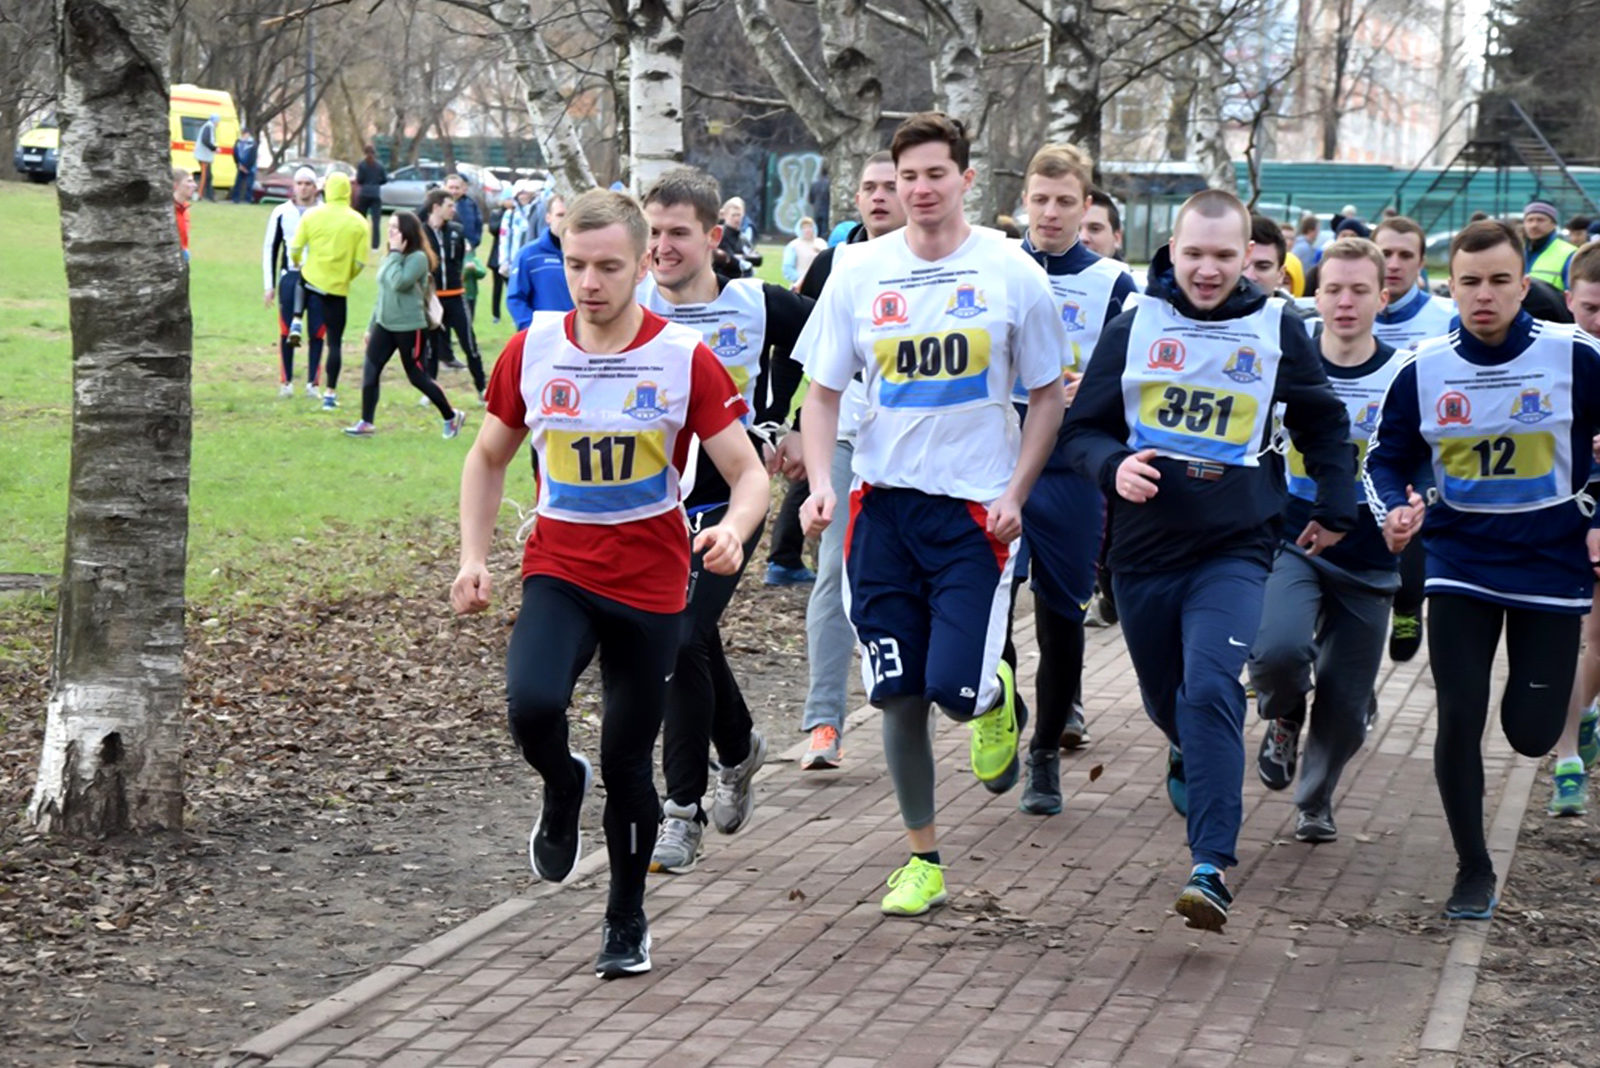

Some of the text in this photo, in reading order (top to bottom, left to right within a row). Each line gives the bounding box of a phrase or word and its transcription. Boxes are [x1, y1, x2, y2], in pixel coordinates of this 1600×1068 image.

[897, 333, 968, 378] 400
[1158, 386, 1234, 437] 351
[571, 436, 636, 481] 117
[1472, 436, 1516, 476] 12
[868, 637, 903, 684] 23
